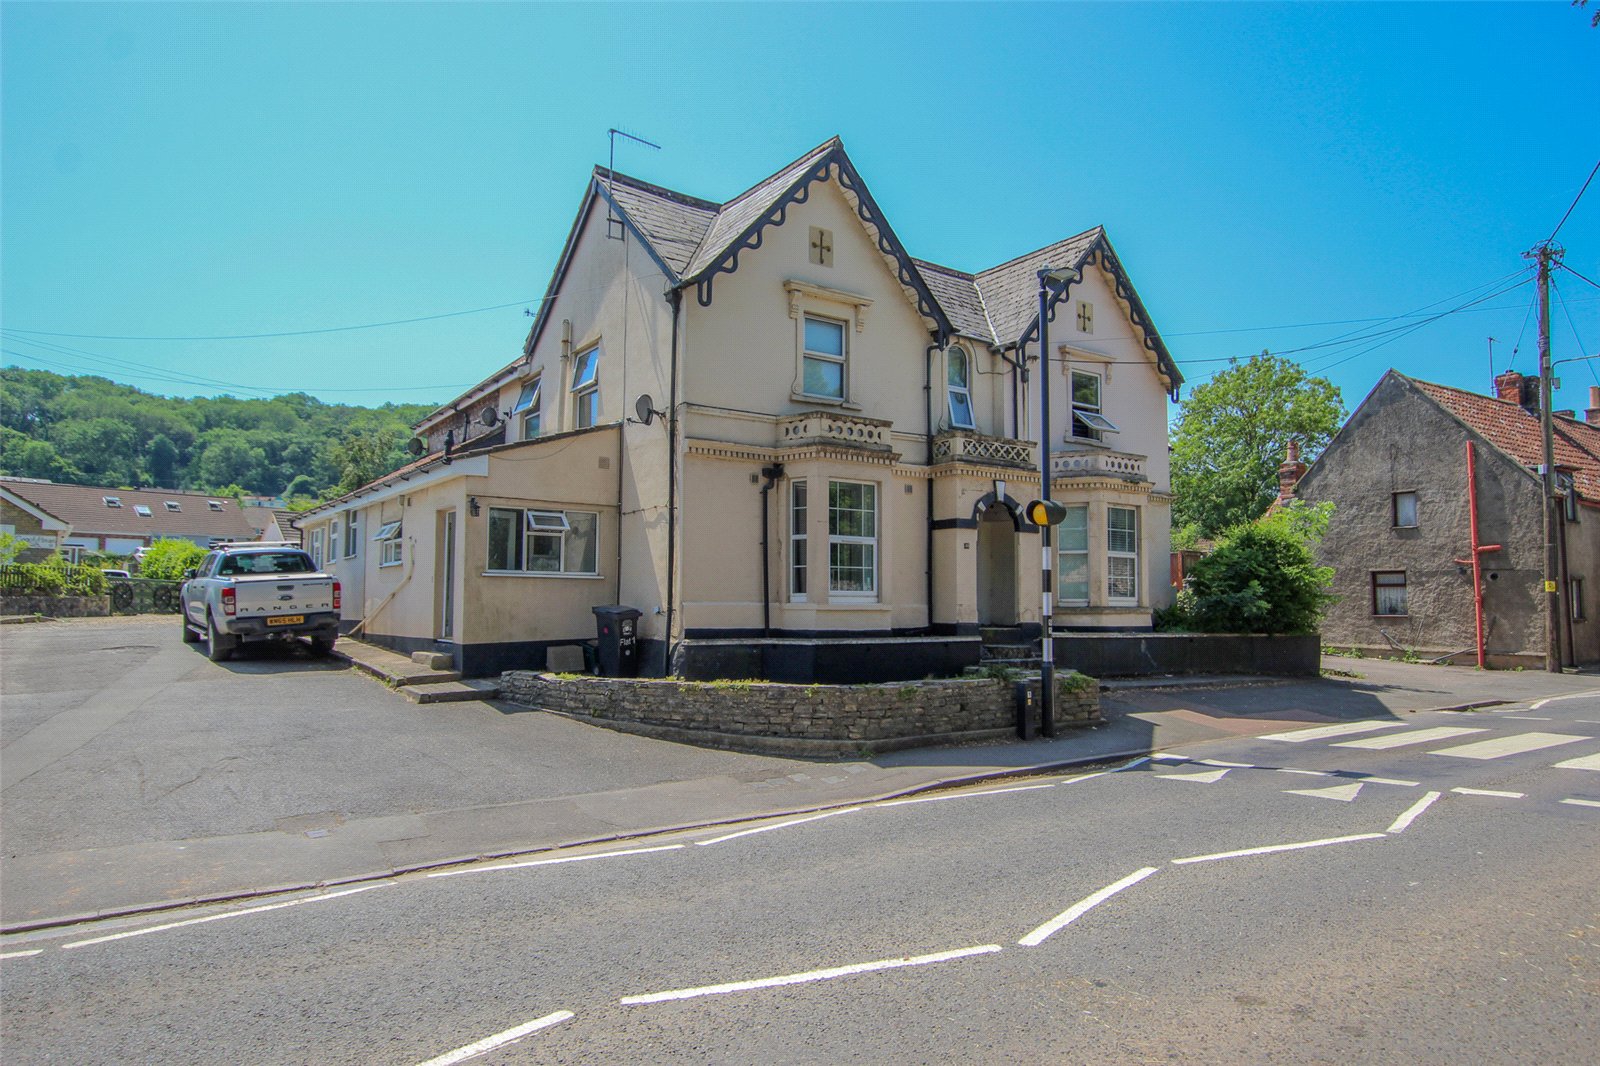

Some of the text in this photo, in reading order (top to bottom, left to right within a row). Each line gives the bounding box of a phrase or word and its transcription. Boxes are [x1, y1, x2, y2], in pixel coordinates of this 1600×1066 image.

[240, 602, 329, 612] RANGER
[619, 636, 636, 646] Flat 1
